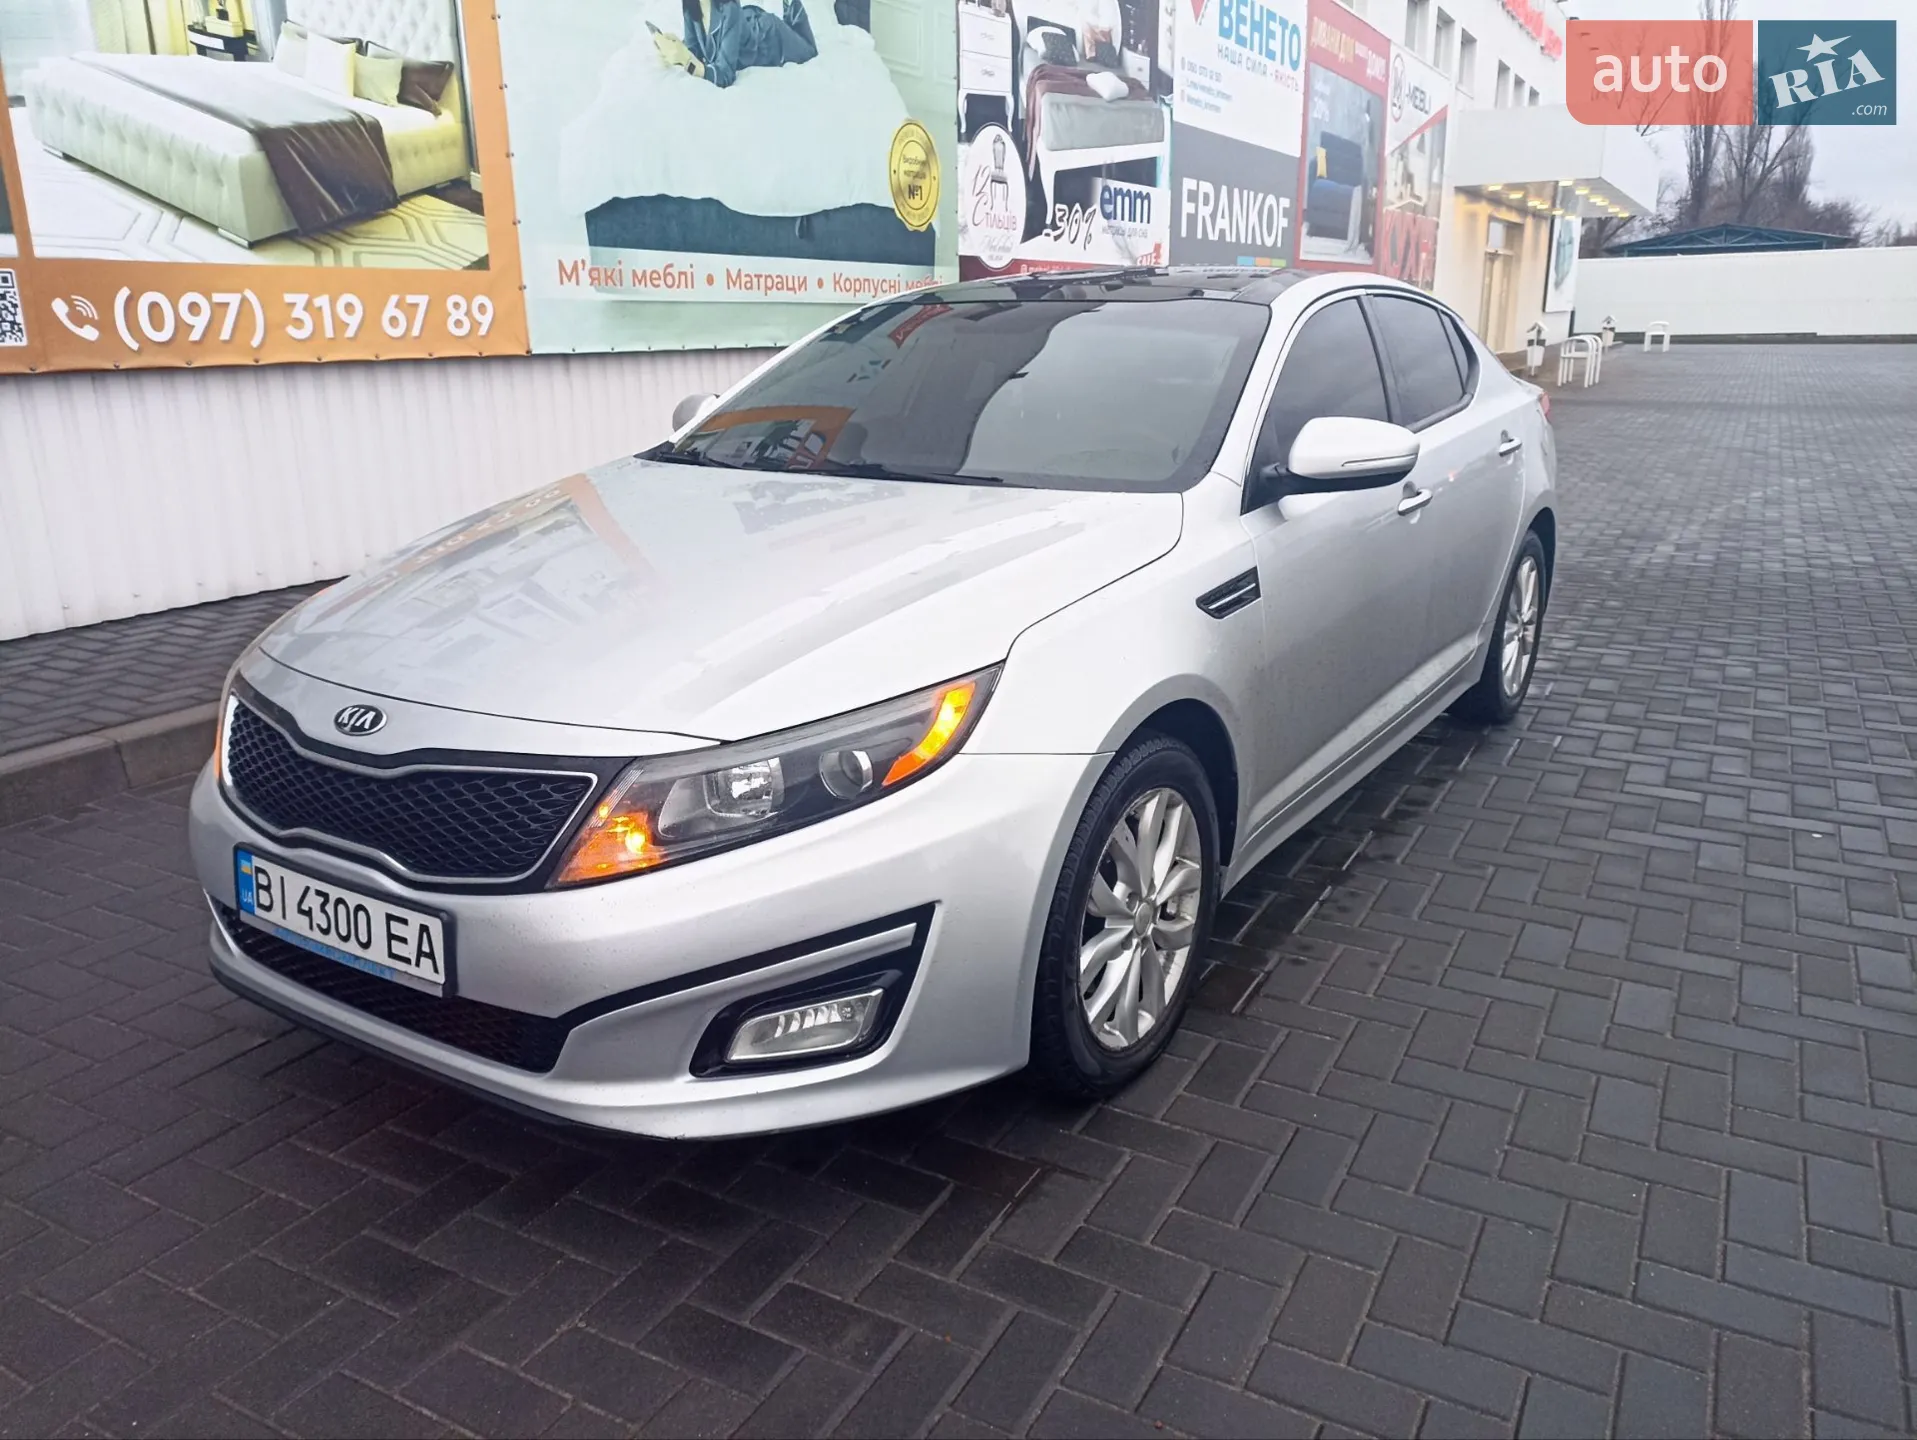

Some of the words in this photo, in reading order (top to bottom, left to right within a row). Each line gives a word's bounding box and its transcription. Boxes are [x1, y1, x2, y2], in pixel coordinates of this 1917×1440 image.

[1217, 43, 1243, 69] НАША
[1245, 56, 1268, 77] СИЛА
[1218, 0, 1301, 72] ВЕНЕТО
[1043, 203, 1097, 251] -30%
[1100, 184, 1151, 225] emm
[1181, 177, 1291, 248] FRANKOF
[632, 263, 696, 290] меблі
[726, 268, 808, 297] Матраци
[833, 272, 901, 299] Корпусні
[114, 285, 265, 351] (097)
[284, 293, 364, 340] 319
[381, 294, 430, 339] 67
[446, 294, 495, 337] 89
[338, 706, 376, 730] KIA
[255, 864, 287, 921] BI
[296, 885, 372, 950] 4300
[385, 912, 440, 976] EA
